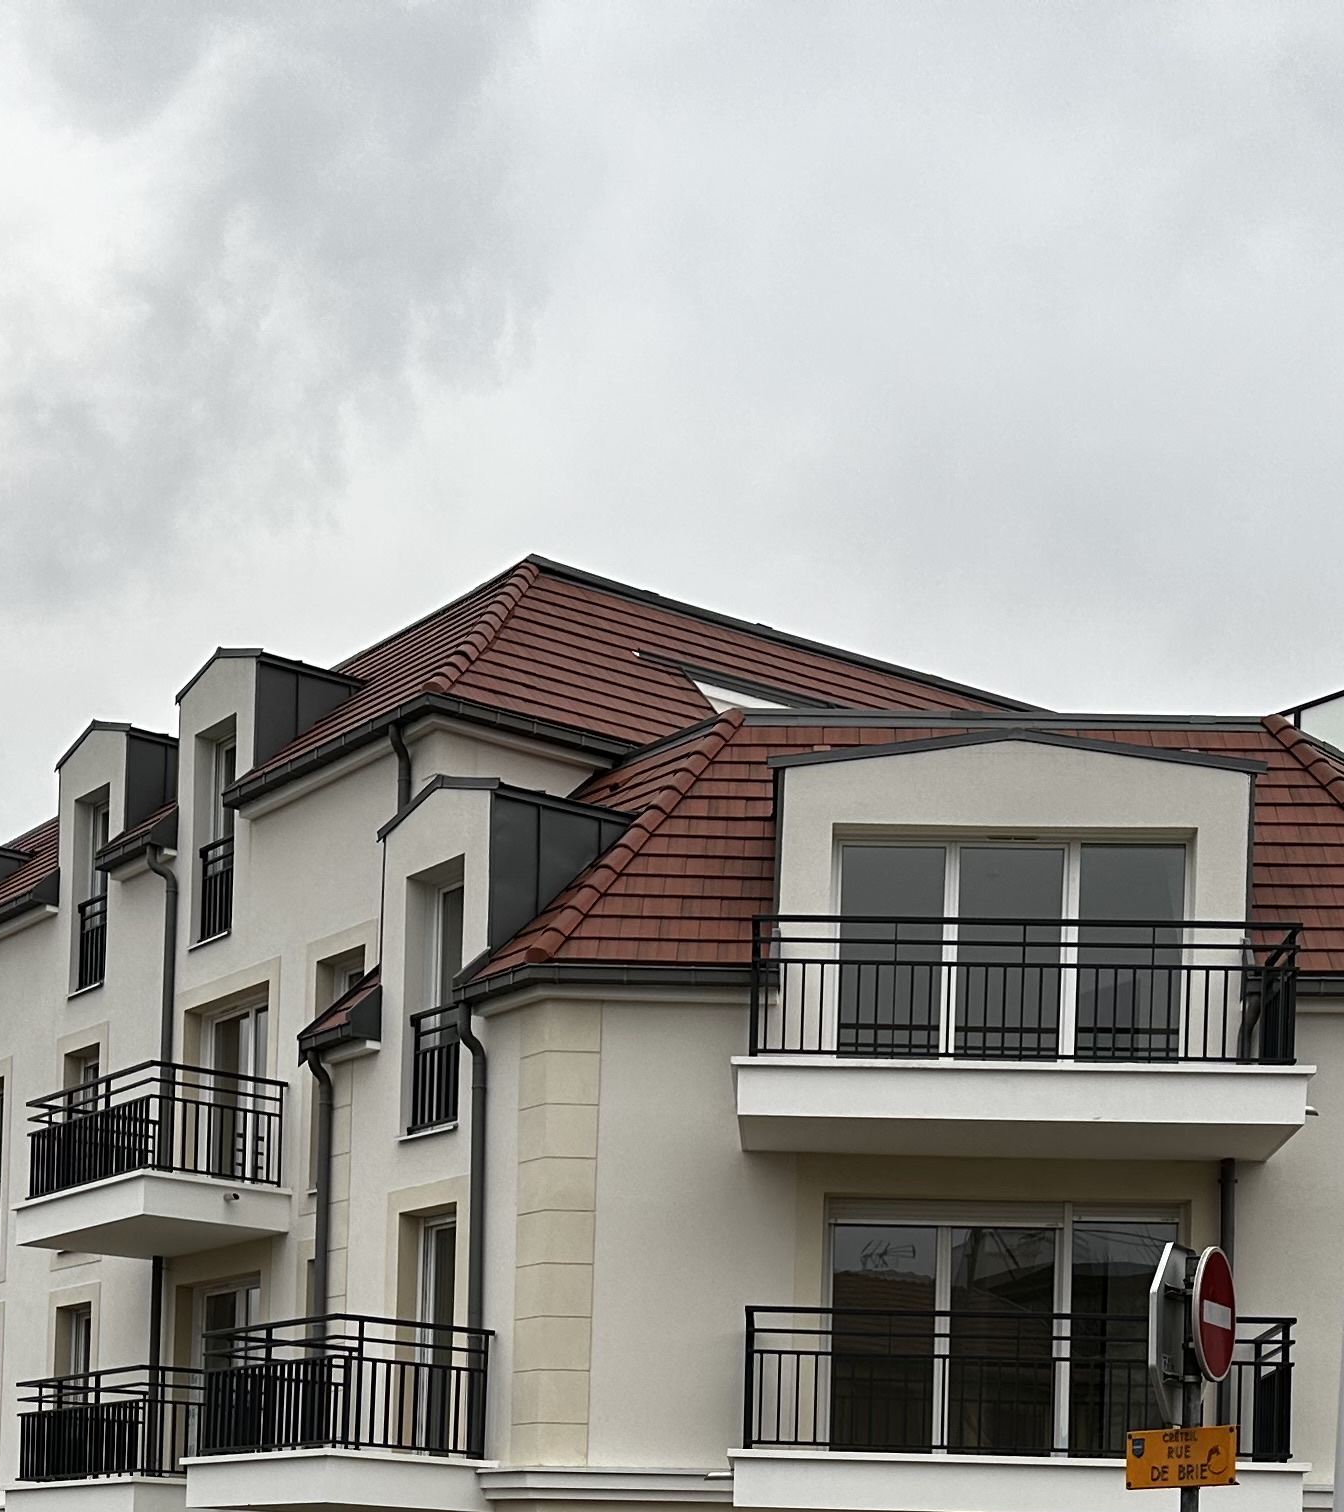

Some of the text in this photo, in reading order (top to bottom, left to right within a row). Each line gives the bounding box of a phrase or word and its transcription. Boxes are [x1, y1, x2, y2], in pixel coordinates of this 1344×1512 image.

[1167, 1445, 1191, 1459] RUE
[1150, 1463, 1208, 1482] DE BRIE
